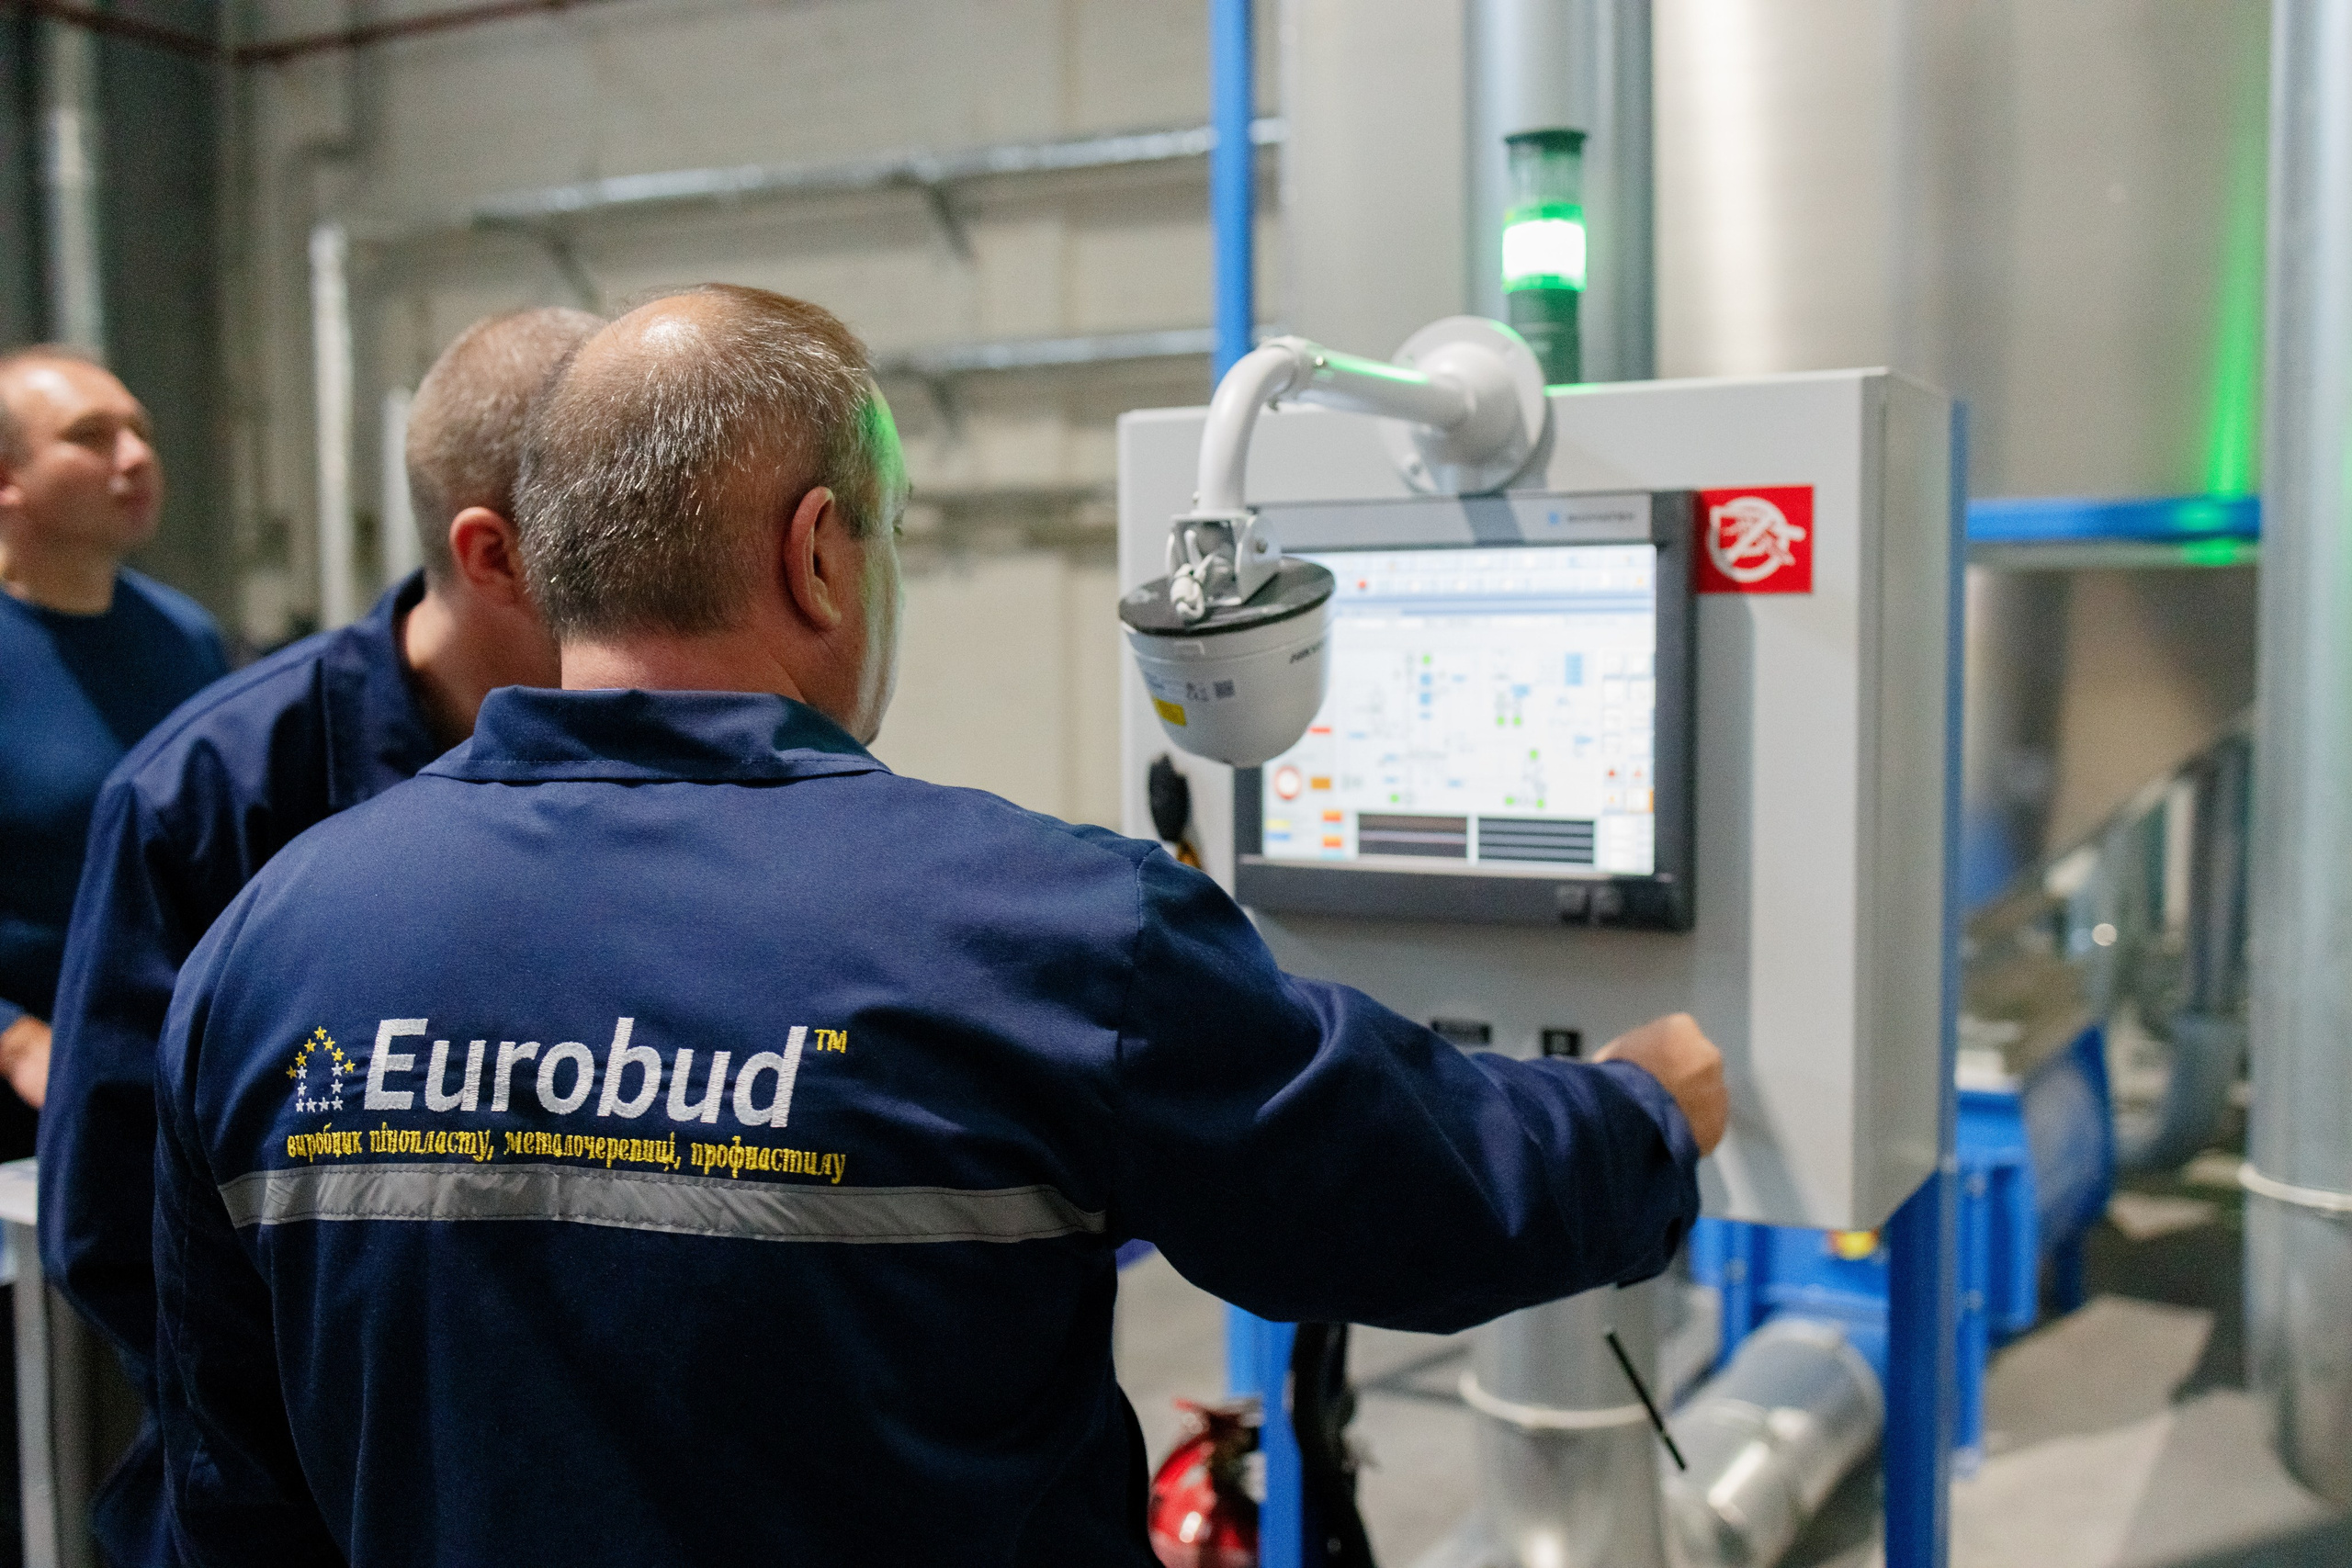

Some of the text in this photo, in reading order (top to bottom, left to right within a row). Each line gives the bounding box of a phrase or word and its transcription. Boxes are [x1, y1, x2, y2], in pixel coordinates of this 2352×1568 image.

[363, 1016, 808, 1128] Eurobud
[287, 1122, 846, 1184] виробник пінопласту, металочерепиці, профнастилу
